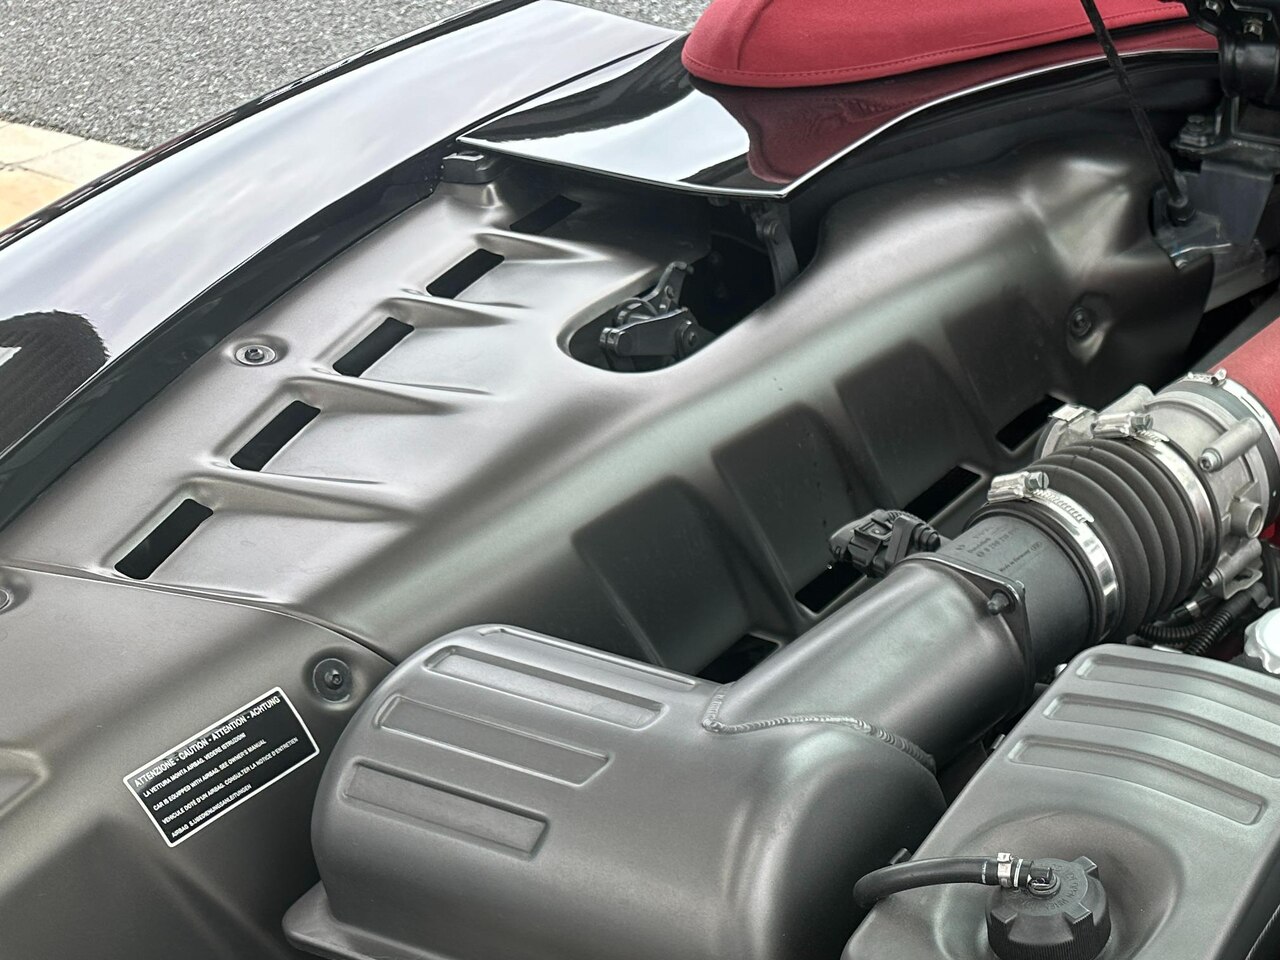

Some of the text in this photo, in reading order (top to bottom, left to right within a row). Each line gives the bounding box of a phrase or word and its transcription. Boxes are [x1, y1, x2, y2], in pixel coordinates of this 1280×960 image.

[134, 757, 176, 787] ATTENZIONE
[178, 737, 208, 759] CAUTION
[211, 715, 247, 740] ATTENTION
[249, 695, 280, 717] ACHTUNG
[149, 777, 171, 793] VETTURA
[152, 801, 164, 810] CAR
[167, 784, 191, 801] EQUIPPED
[189, 777, 202, 787] WITH
[218, 761, 229, 770] SEE
[246, 739, 266, 752] MANUAL
[171, 823, 189, 837] AIRBAG
